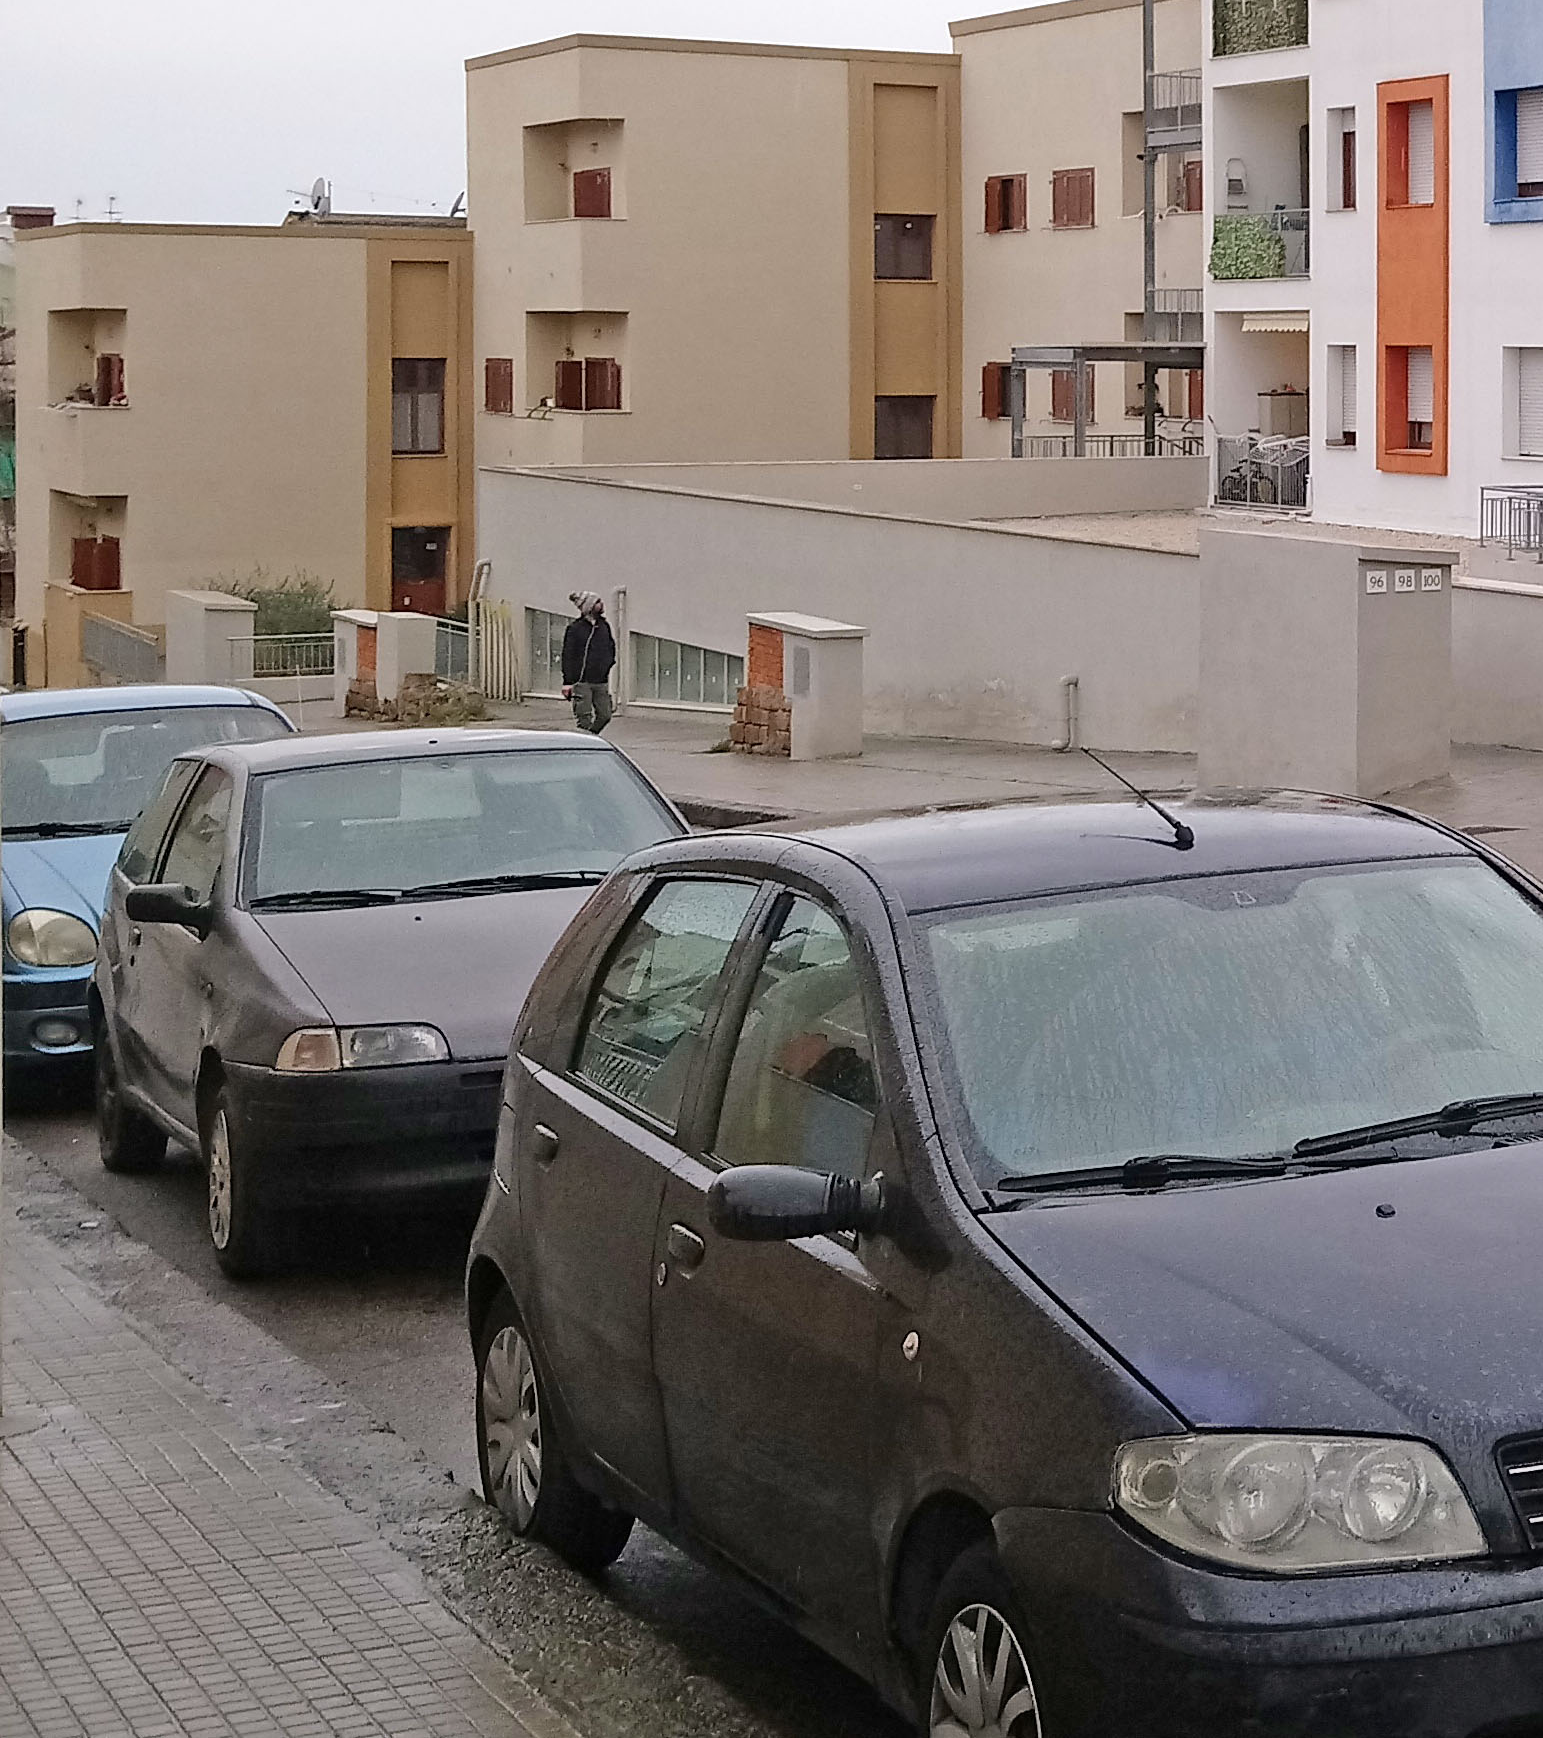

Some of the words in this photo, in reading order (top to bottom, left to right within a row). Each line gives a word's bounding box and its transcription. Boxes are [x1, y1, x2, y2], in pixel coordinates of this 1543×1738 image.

[1369, 576, 1385, 588] 96
[1398, 575, 1413, 588] 98
[1423, 574, 1441, 588] 100
